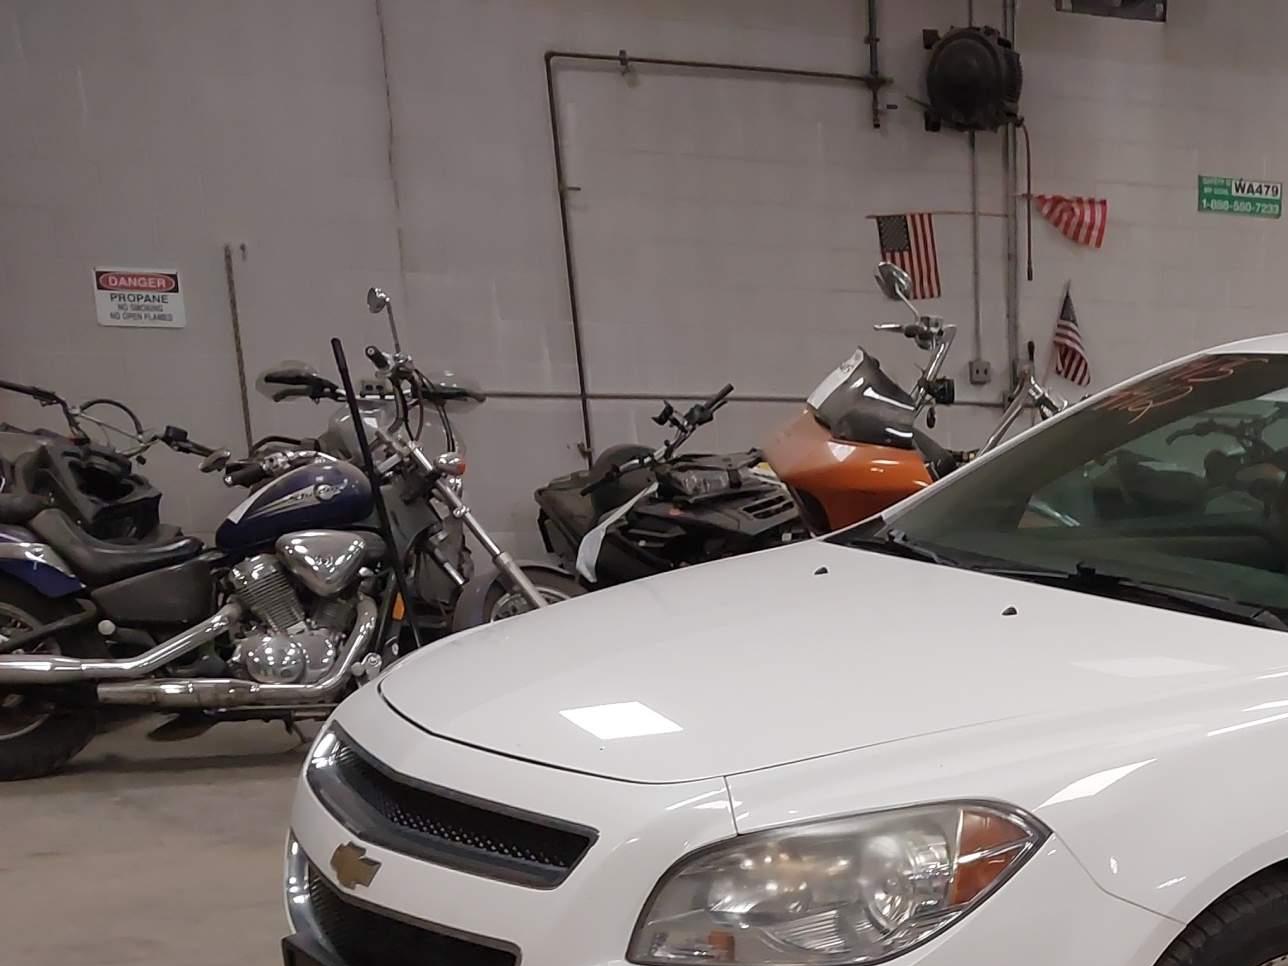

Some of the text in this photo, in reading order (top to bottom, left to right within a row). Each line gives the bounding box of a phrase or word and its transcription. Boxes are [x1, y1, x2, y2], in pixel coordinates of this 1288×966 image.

[1234, 181, 1279, 197] WA479
[107, 275, 167, 289] DANGER
[110, 292, 169, 304] PROPANE
